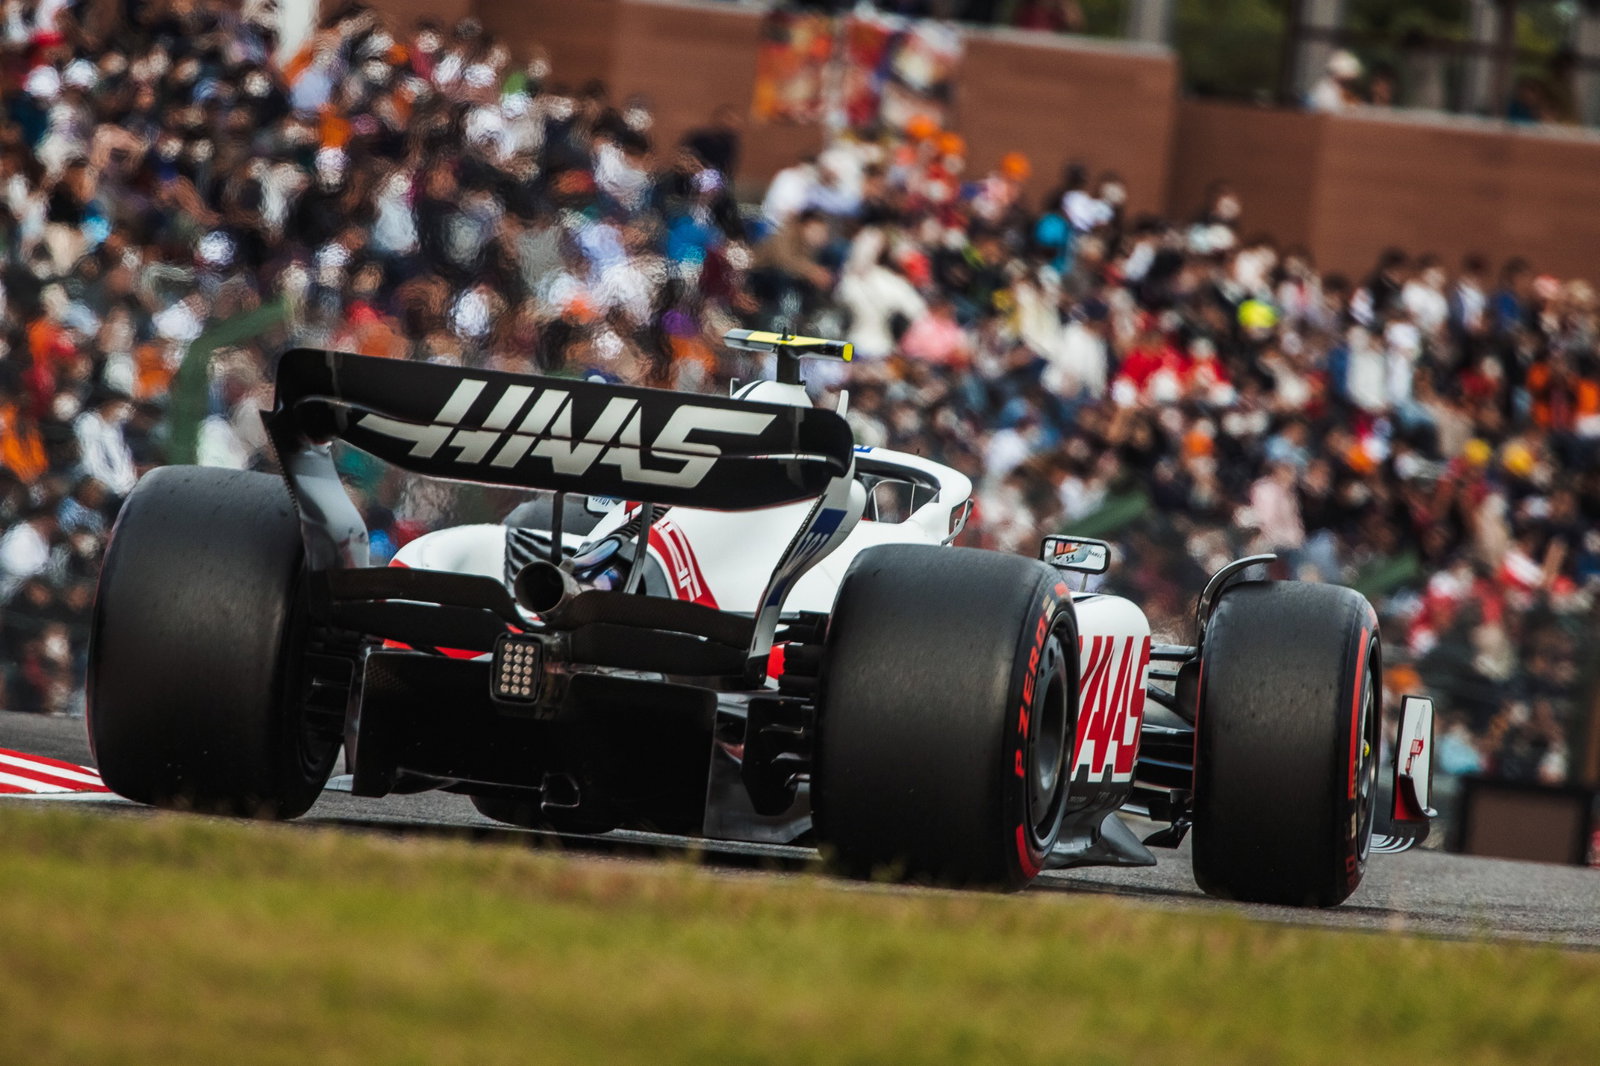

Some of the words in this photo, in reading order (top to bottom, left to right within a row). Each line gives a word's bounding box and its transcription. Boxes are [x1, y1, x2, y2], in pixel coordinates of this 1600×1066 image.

[357, 378, 778, 489] HAAS
[1017, 615, 1049, 740] ZERO
[1014, 749, 1025, 778] P
